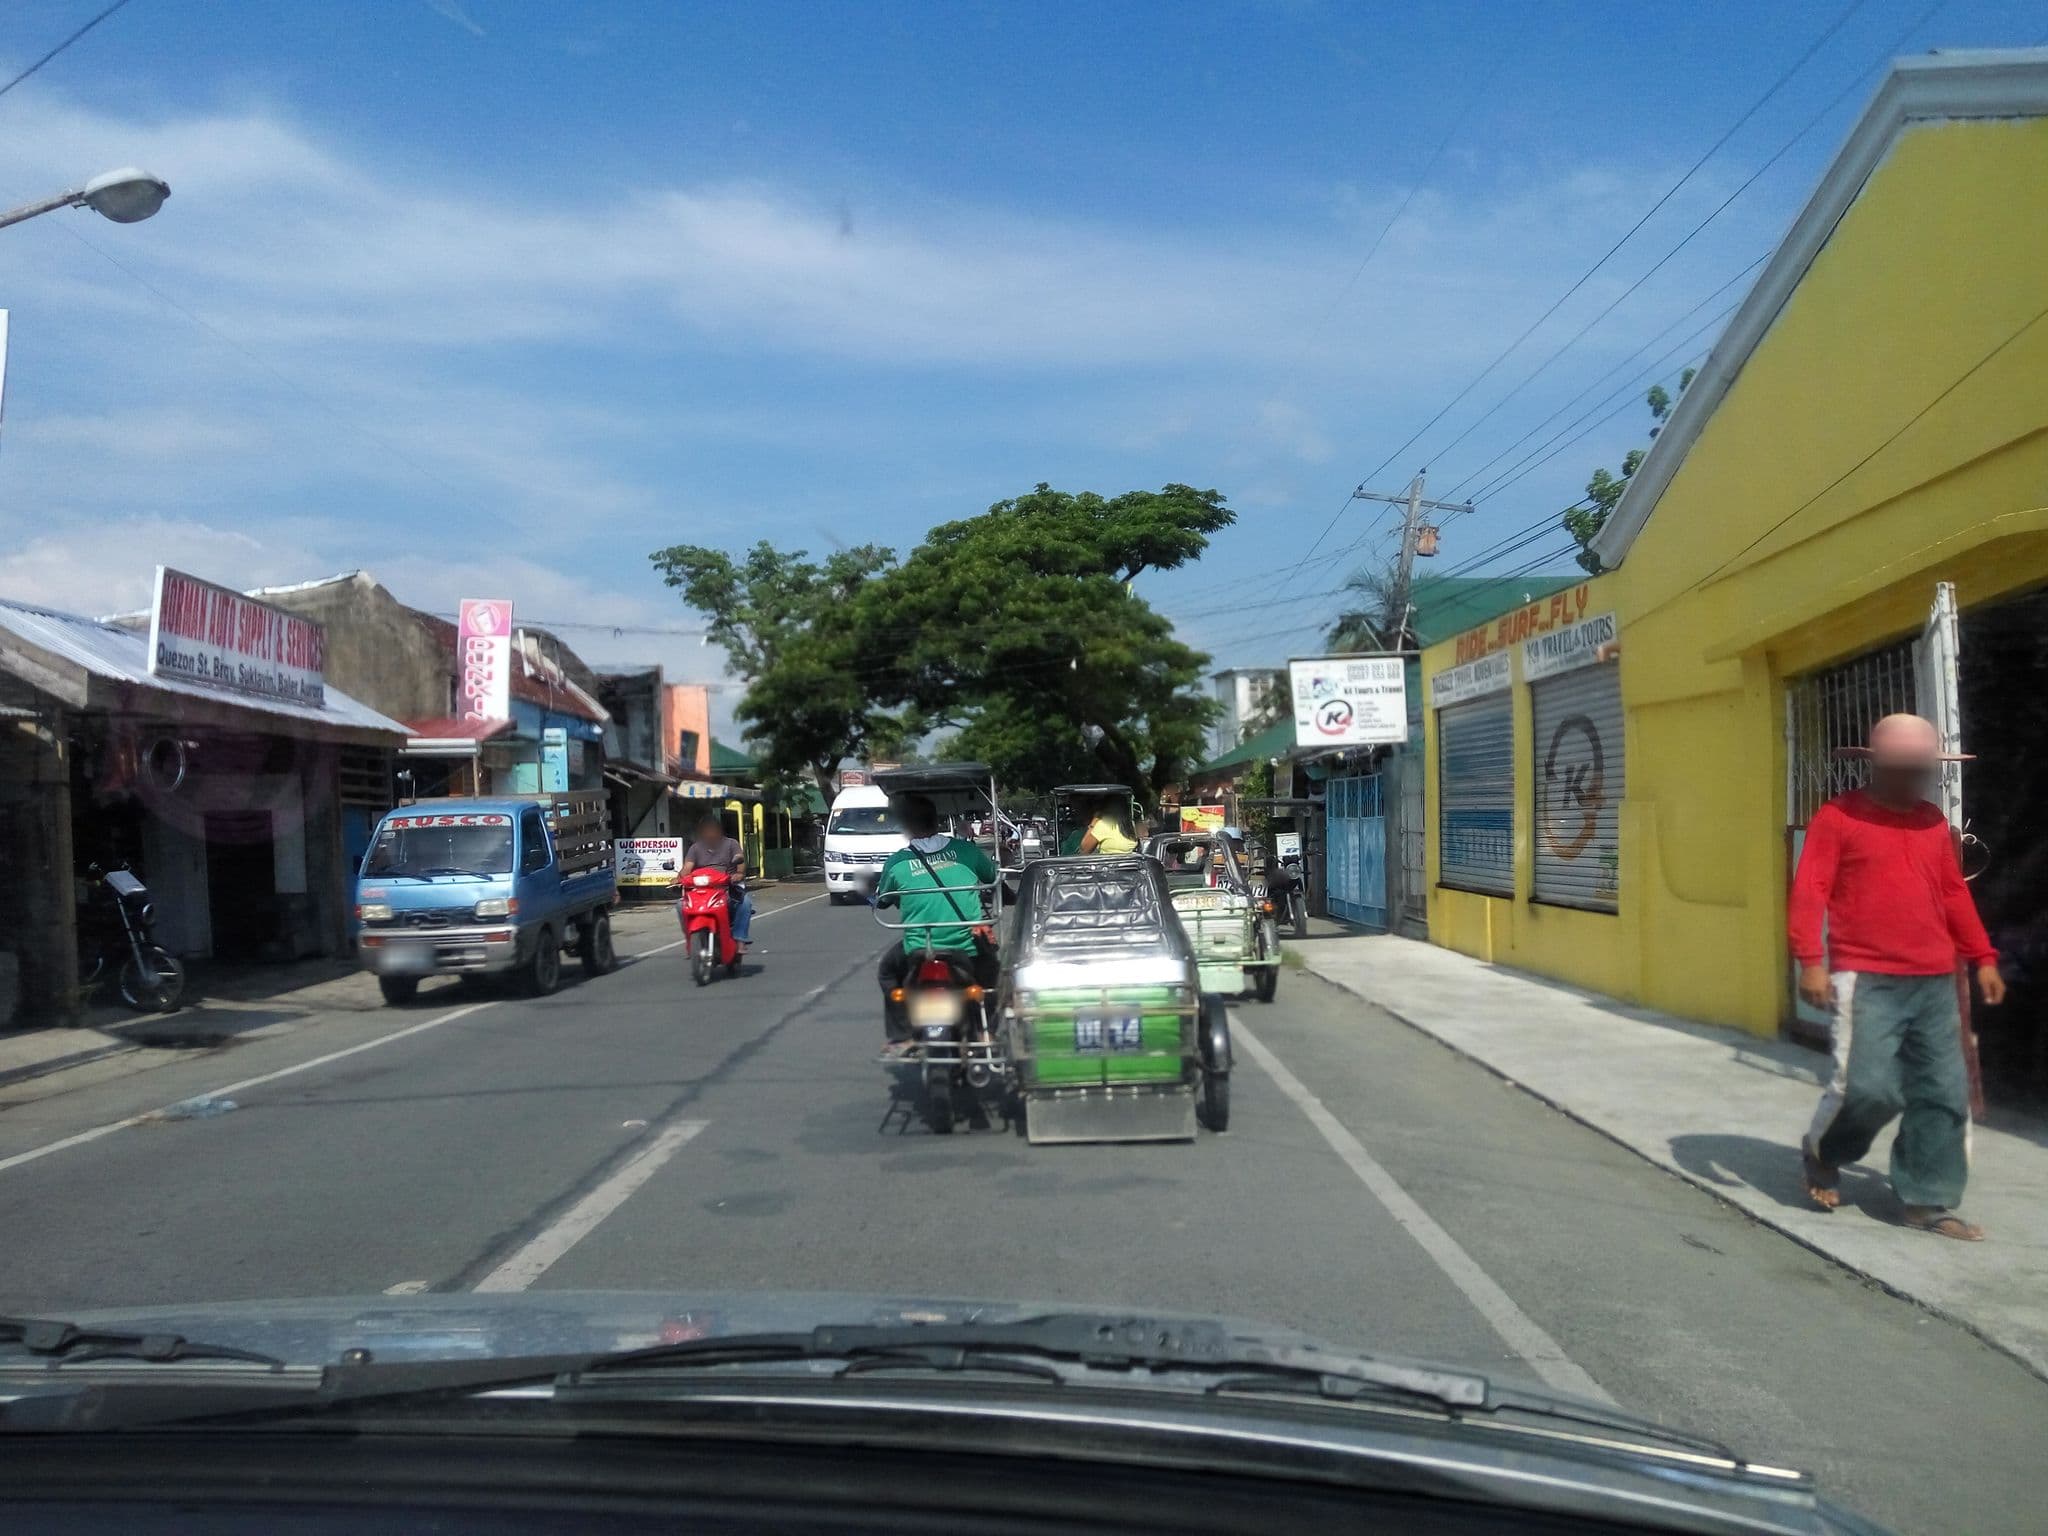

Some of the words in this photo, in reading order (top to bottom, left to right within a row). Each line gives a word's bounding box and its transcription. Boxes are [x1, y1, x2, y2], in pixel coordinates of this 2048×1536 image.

[1551, 583, 1589, 630] FLY
[209, 590, 236, 651] AUTO
[238, 602, 274, 660] SUPPLY
[276, 614, 284, 665] &
[1580, 615, 1613, 650] TOURS
[157, 642, 195, 672] Quezon
[197, 652, 210, 676] St.
[392, 815, 503, 829] RUSCO
[619, 840, 678, 849] WONDERSAW
